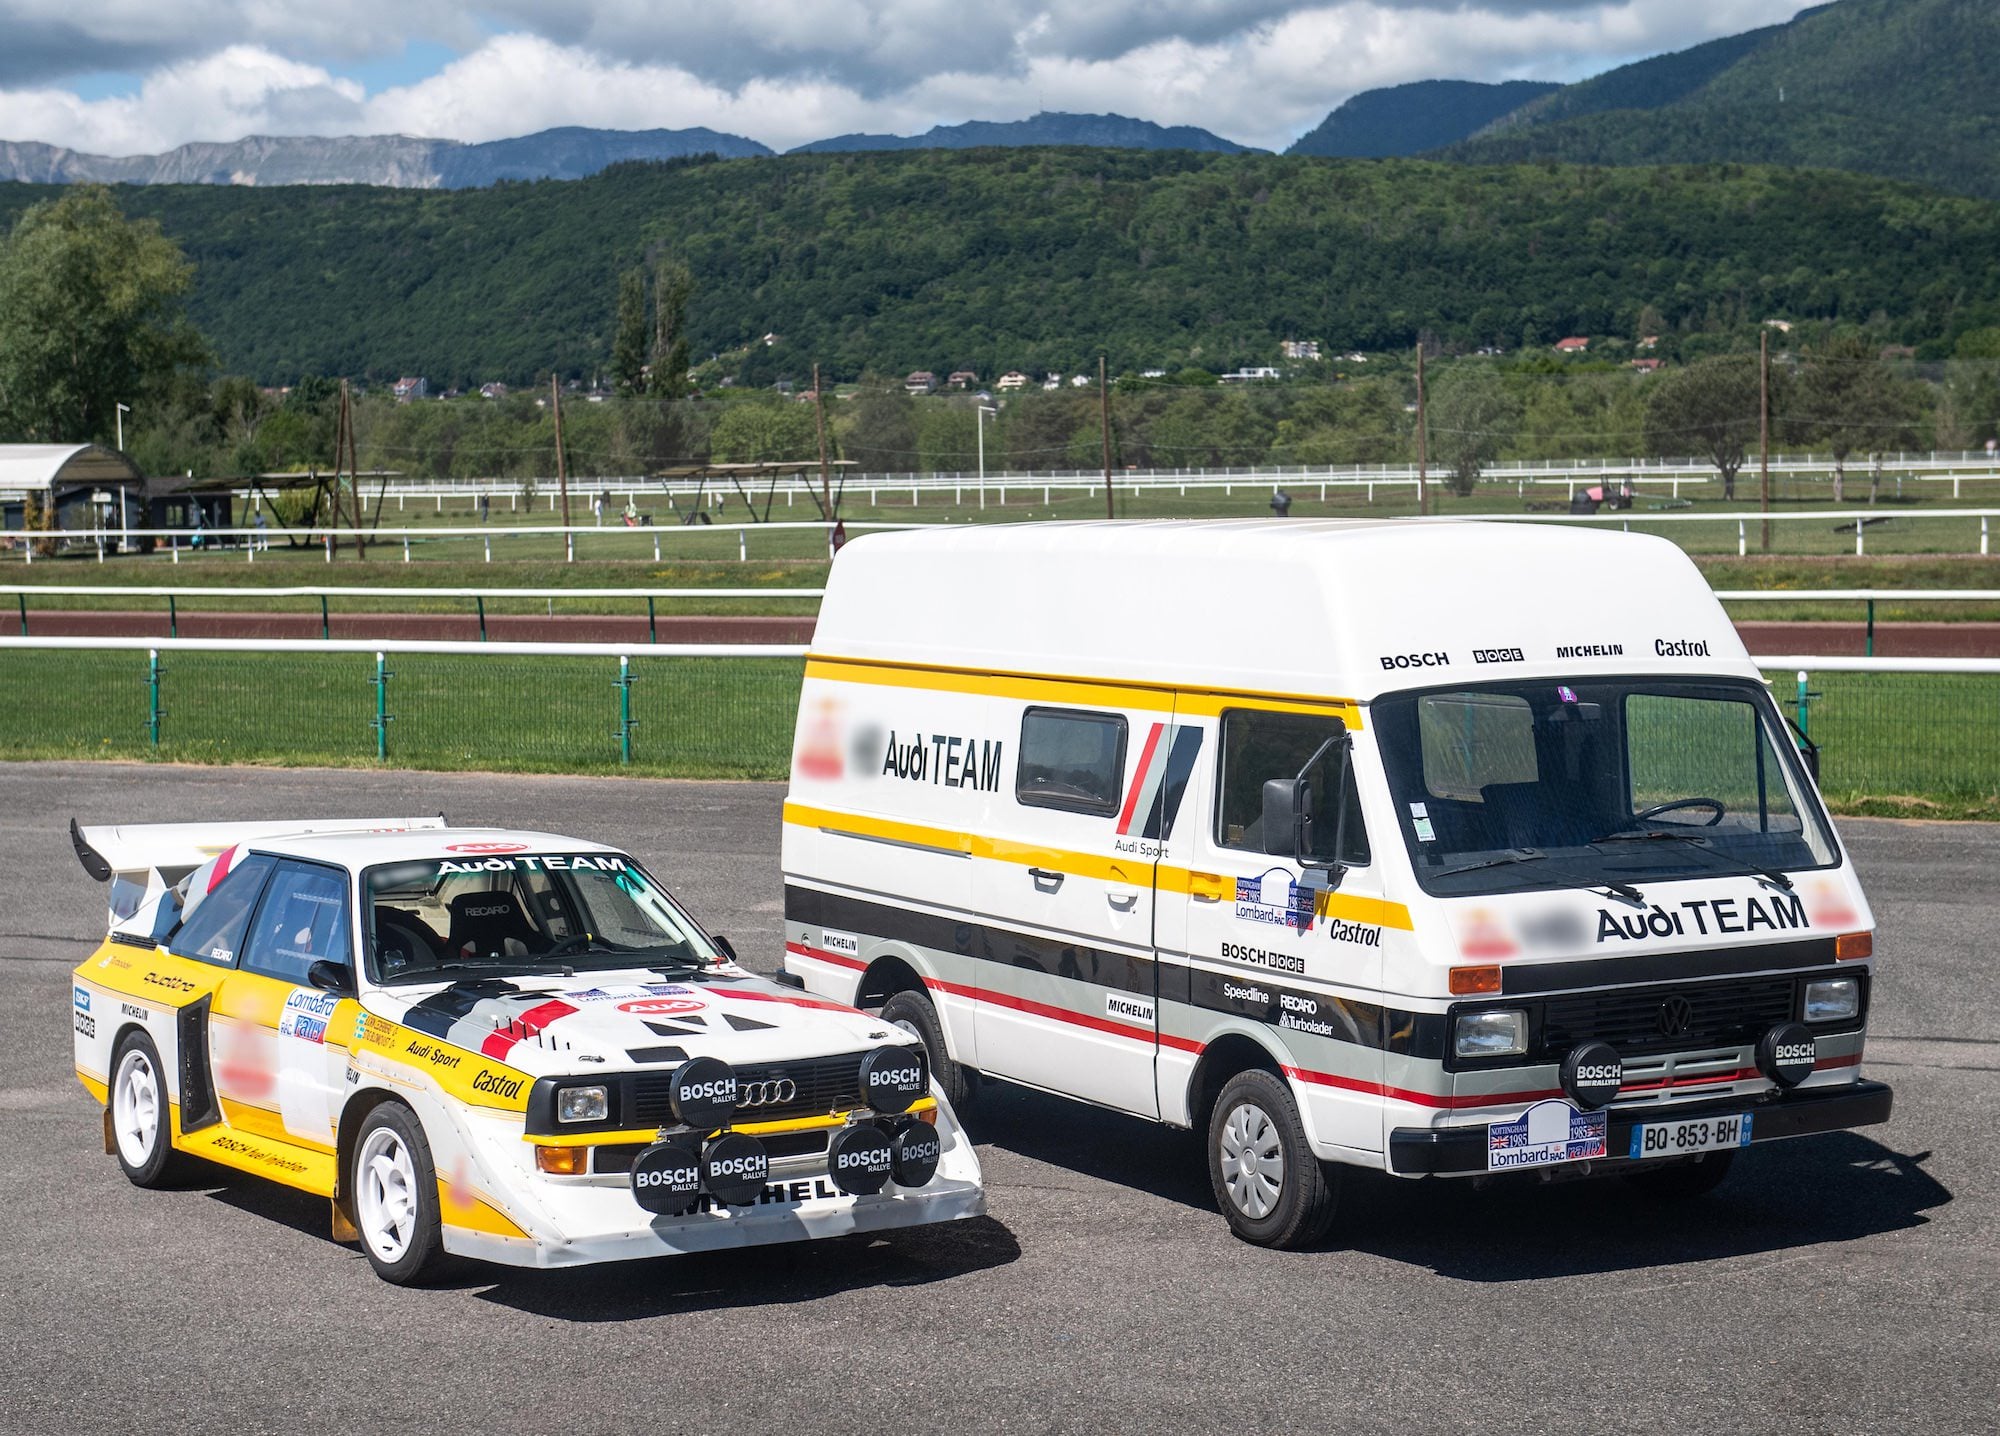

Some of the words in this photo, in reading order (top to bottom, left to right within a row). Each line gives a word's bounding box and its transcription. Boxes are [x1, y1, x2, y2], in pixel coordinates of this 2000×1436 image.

[1472, 648, 1525, 663] BOGE
[1557, 644, 1623, 658] MICHELIN
[1655, 638, 1711, 657] Castrol
[1380, 651, 1450, 670] BOSCH
[883, 730, 928, 779] Audi
[932, 734, 1002, 793] TEAM
[1115, 839, 1138, 855] Audi
[1140, 843, 1170, 859] Sport
[437, 857, 517, 875] Audi
[515, 856, 627, 872] TEAM
[465, 904, 510, 917] RECARO
[1235, 903, 1274, 922] Lombard
[1597, 904, 1684, 943] Audi
[1681, 895, 1809, 935] TEAM
[1330, 919, 1381, 948] Castrol
[823, 935, 857, 953] MICHELIN
[211, 948, 233, 962] RECARO
[1222, 943, 1266, 965] BOSCH
[1269, 952, 1305, 973] BOGE
[144, 972, 196, 993] quattro
[75, 988, 90, 1005] SKF
[287, 988, 340, 1017] Lombard
[1223, 983, 1269, 1004] Speedline
[121, 1003, 149, 1021] MICHELIN
[1108, 999, 1154, 1020] MICHELIN
[1280, 994, 1317, 1014] RECARO
[294, 1014, 326, 1041] rally
[1288, 1016, 1333, 1036] Turbolader
[406, 1041, 432, 1058] Audi
[430, 1048, 461, 1068] Sport
[1776, 1043, 1815, 1058] BOSCH
[870, 1068, 920, 1086] BOSCH
[1577, 1065, 1621, 1079] BOSCH
[473, 1069, 524, 1100] Castrol
[680, 1079, 737, 1101] BOSCH
[898, 1083, 920, 1092] RALLYE
[712, 1094, 737, 1104] RALLYE
[1570, 1112, 1605, 1126] NOTTINGHAM
[1491, 1124, 1528, 1136] NOTTINGHAM
[1571, 1125, 1587, 1139] 1985
[1645, 1119, 1739, 1151] BQ-853-BH
[1741, 1131, 1751, 1142] 01
[1509, 1134, 1528, 1148] 1985
[211, 1137, 250, 1154] BOSCH
[246, 1149, 272, 1161] fuel
[264, 1154, 309, 1173] injection
[838, 1148, 891, 1169] BOSCH
[902, 1141, 939, 1161] BOSCH
[1491, 1146, 1549, 1167] Lombard
[1550, 1152, 1566, 1161] RAC
[1567, 1140, 1602, 1160] rally
[710, 1155, 767, 1177] BOSCH
[868, 1163, 891, 1172] RALLYE
[636, 1167, 698, 1188] BOSCH
[742, 1171, 767, 1181] RALLYE
[671, 1183, 699, 1192] RALLYE
